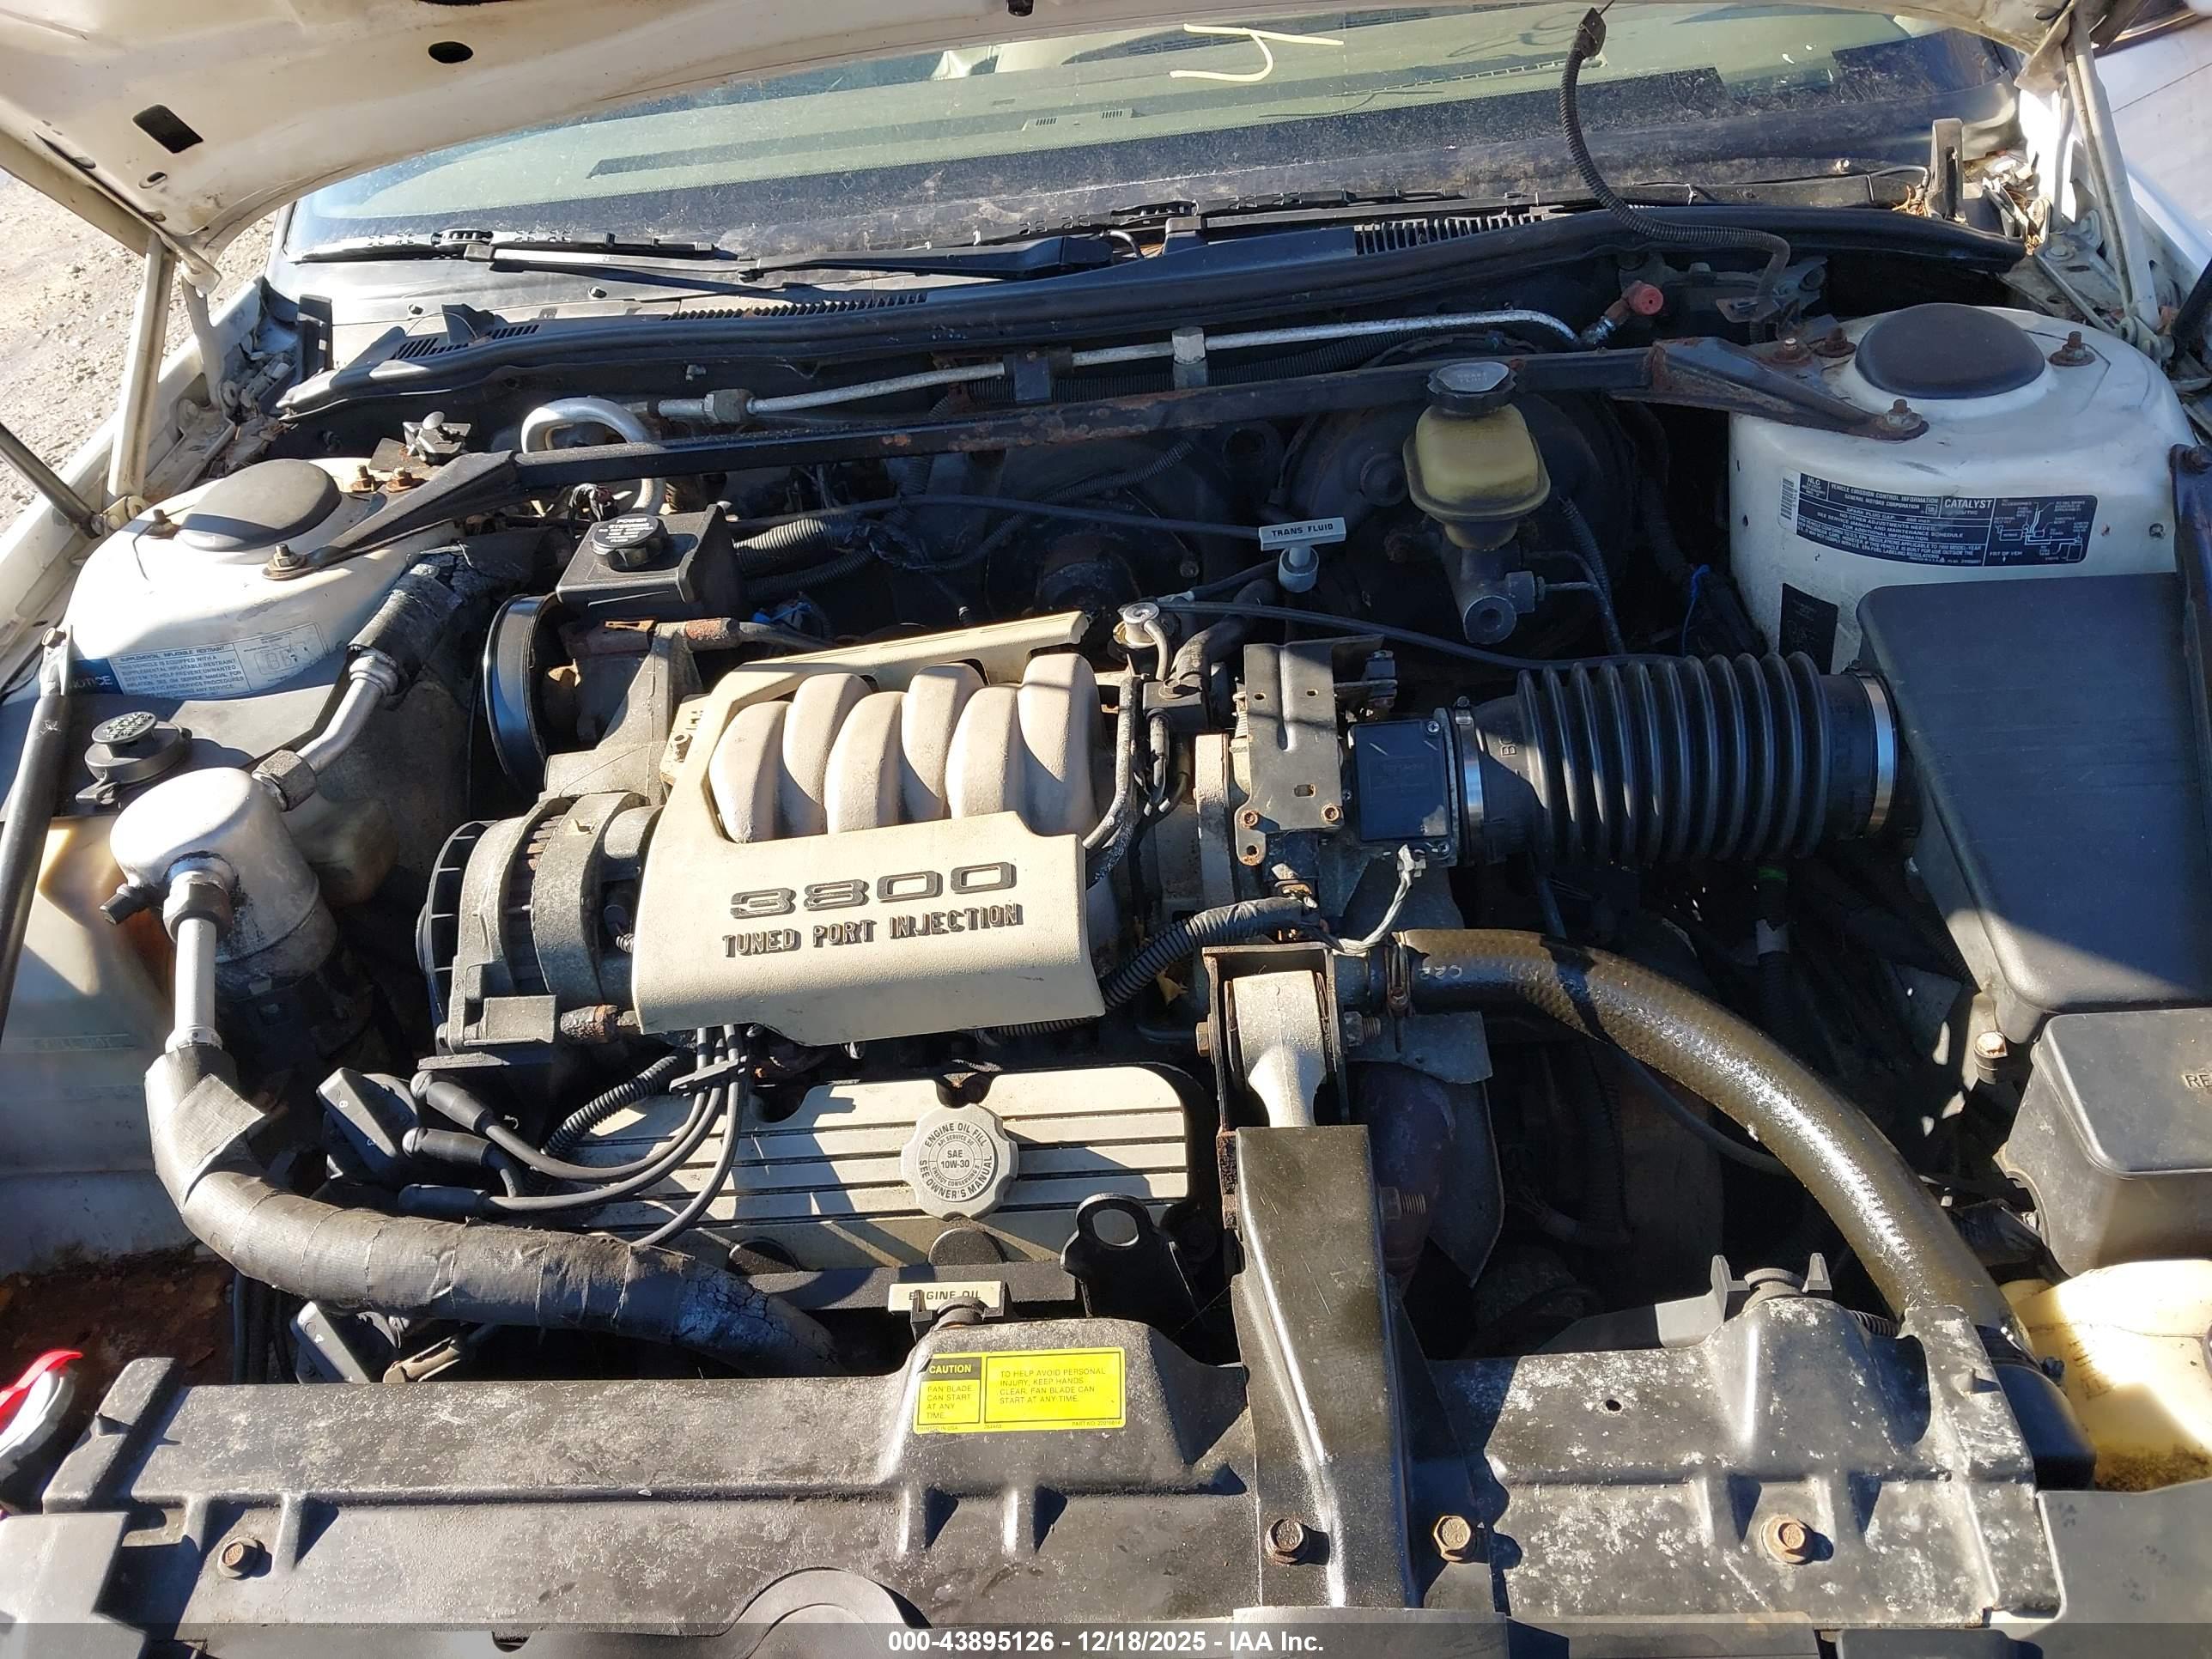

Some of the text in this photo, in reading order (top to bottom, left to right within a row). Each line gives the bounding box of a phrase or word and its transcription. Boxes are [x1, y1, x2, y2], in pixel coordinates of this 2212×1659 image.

[1944, 498, 1992, 509] CATALYST
[1271, 523, 1334, 537] TRANS FLUID
[730, 861, 1018, 919] 3800
[721, 902, 1024, 957] TUNED PORT INJECTION
[925, 1122, 988, 1148] ENGINE OIL FILL
[945, 1133, 967, 1142] SERVICE
[947, 1149, 963, 1158] SAE
[940, 1159, 970, 1169] 10W-30
[919, 1155, 993, 1200] SEE OWNER'S MANUAL
[908, 1290, 981, 1301] EGINE OIL
[928, 1364, 972, 1374] CAUTION
[1013, 1370, 1034, 1378] HELP
[1063, 1367, 1106, 1376] PERSONAL
[1000, 1379, 1030, 1388] INJURY,
[1055, 1376, 1085, 1385] HANDS
[1000, 1396, 1024, 1405] START
